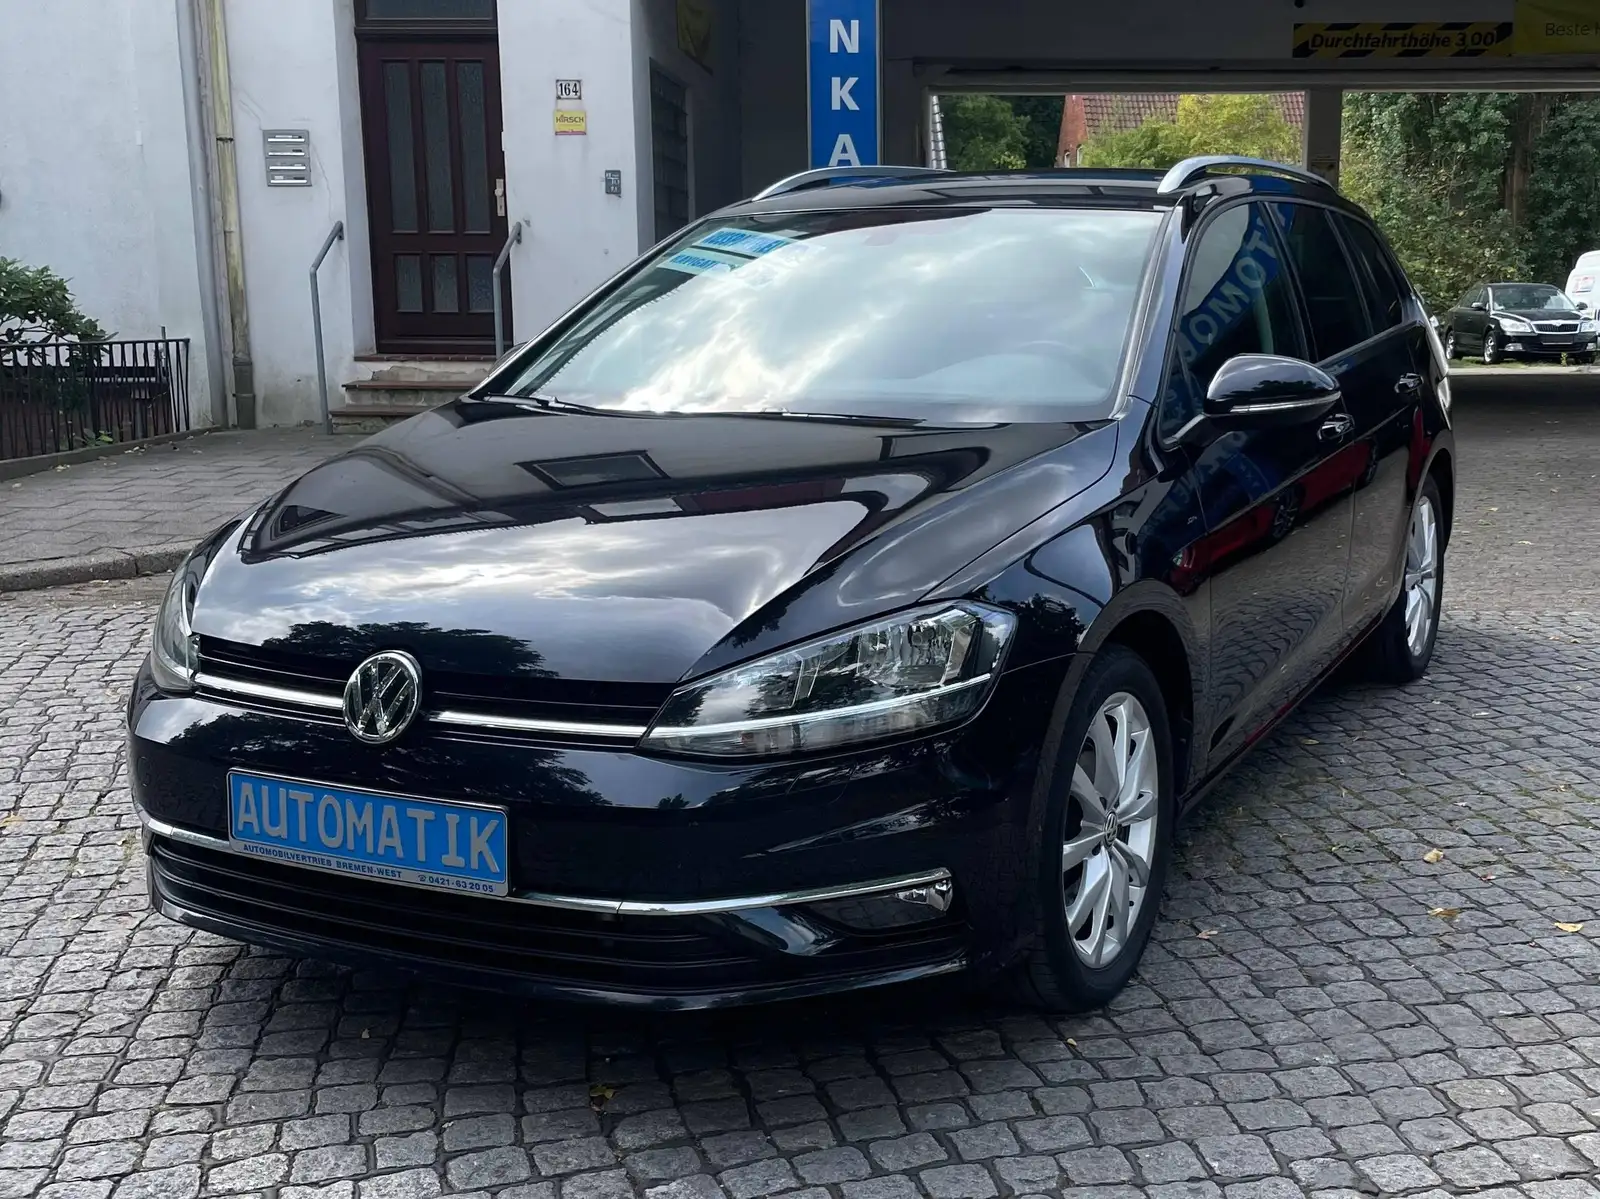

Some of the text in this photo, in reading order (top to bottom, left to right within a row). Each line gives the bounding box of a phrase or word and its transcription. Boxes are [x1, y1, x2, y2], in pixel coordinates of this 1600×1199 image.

[1545, 22, 1590, 36] Beste
[1310, 32, 1450, 49] Durchfahrthöhe
[558, 82, 579, 96] 164
[237, 781, 500, 874] AUTOMATIK
[243, 843, 332, 868] AUTOMOBILVERTRIEB
[336, 860, 402, 879] BREMEN-WEST
